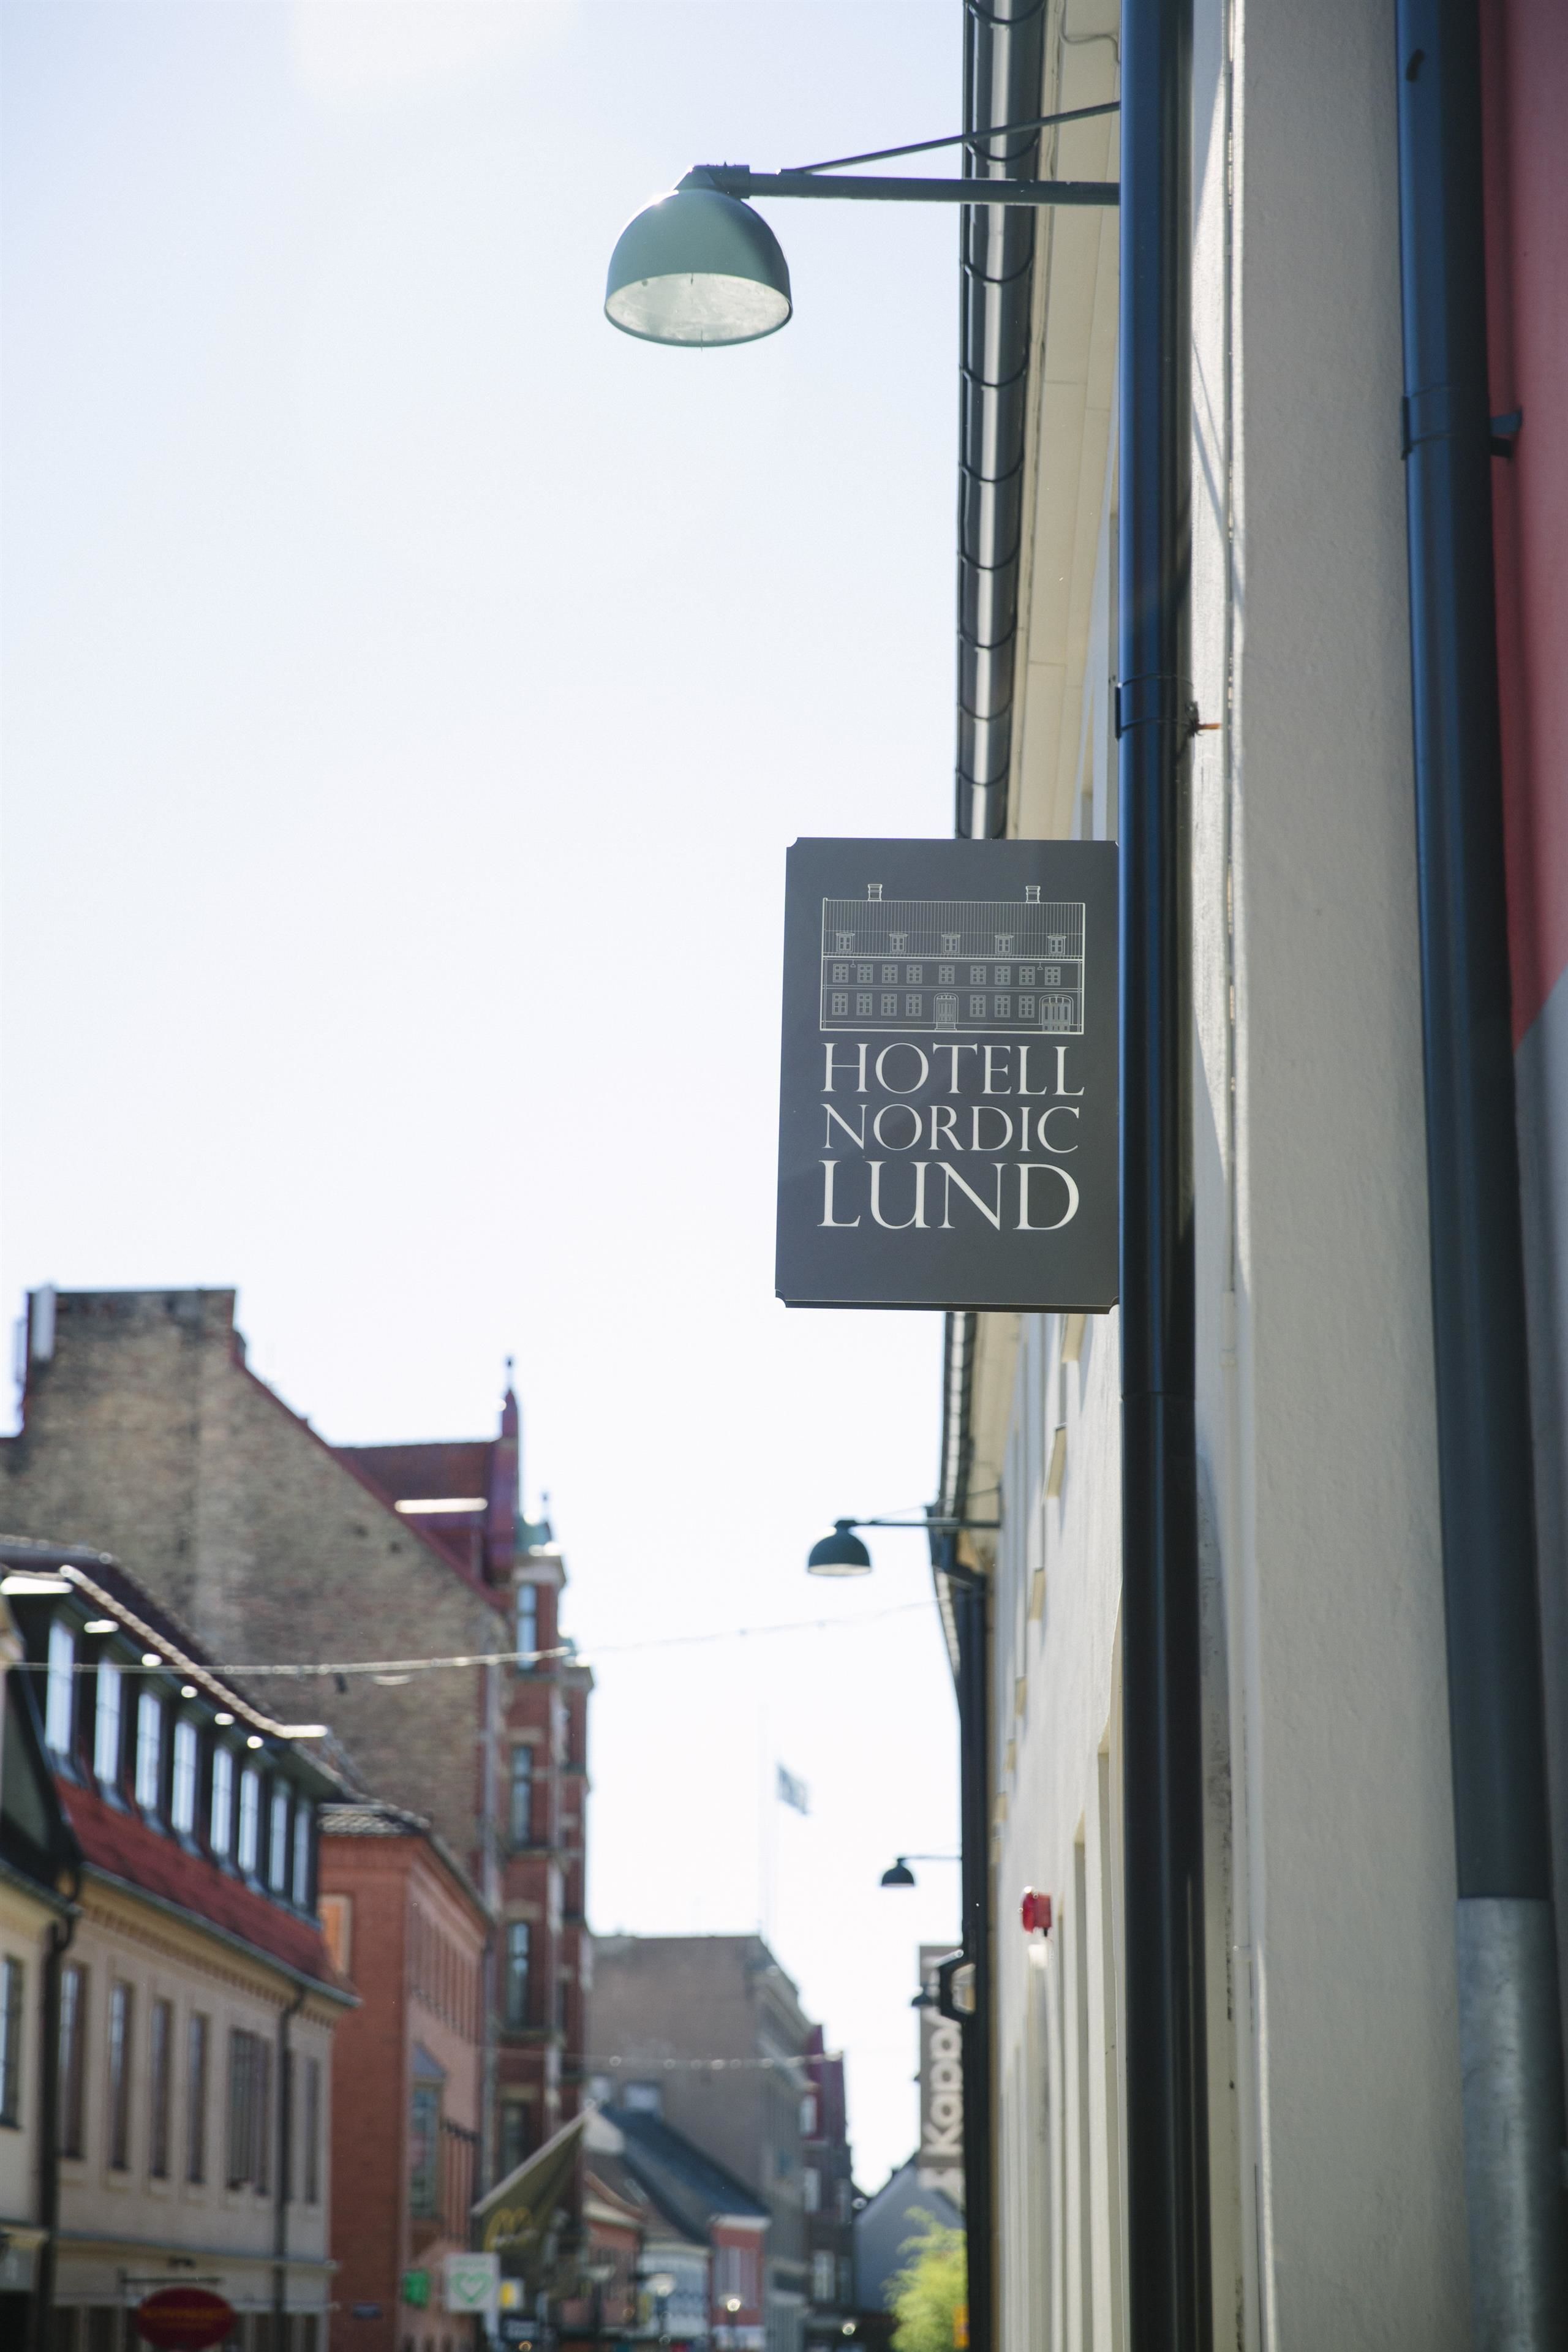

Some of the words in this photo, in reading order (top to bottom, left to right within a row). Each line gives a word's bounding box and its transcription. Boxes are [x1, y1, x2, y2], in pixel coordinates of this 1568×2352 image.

[820, 1042, 1085, 1096] HOTELL
[820, 1102, 1080, 1153] NORDIC
[816, 1159, 1080, 1231] LUND
